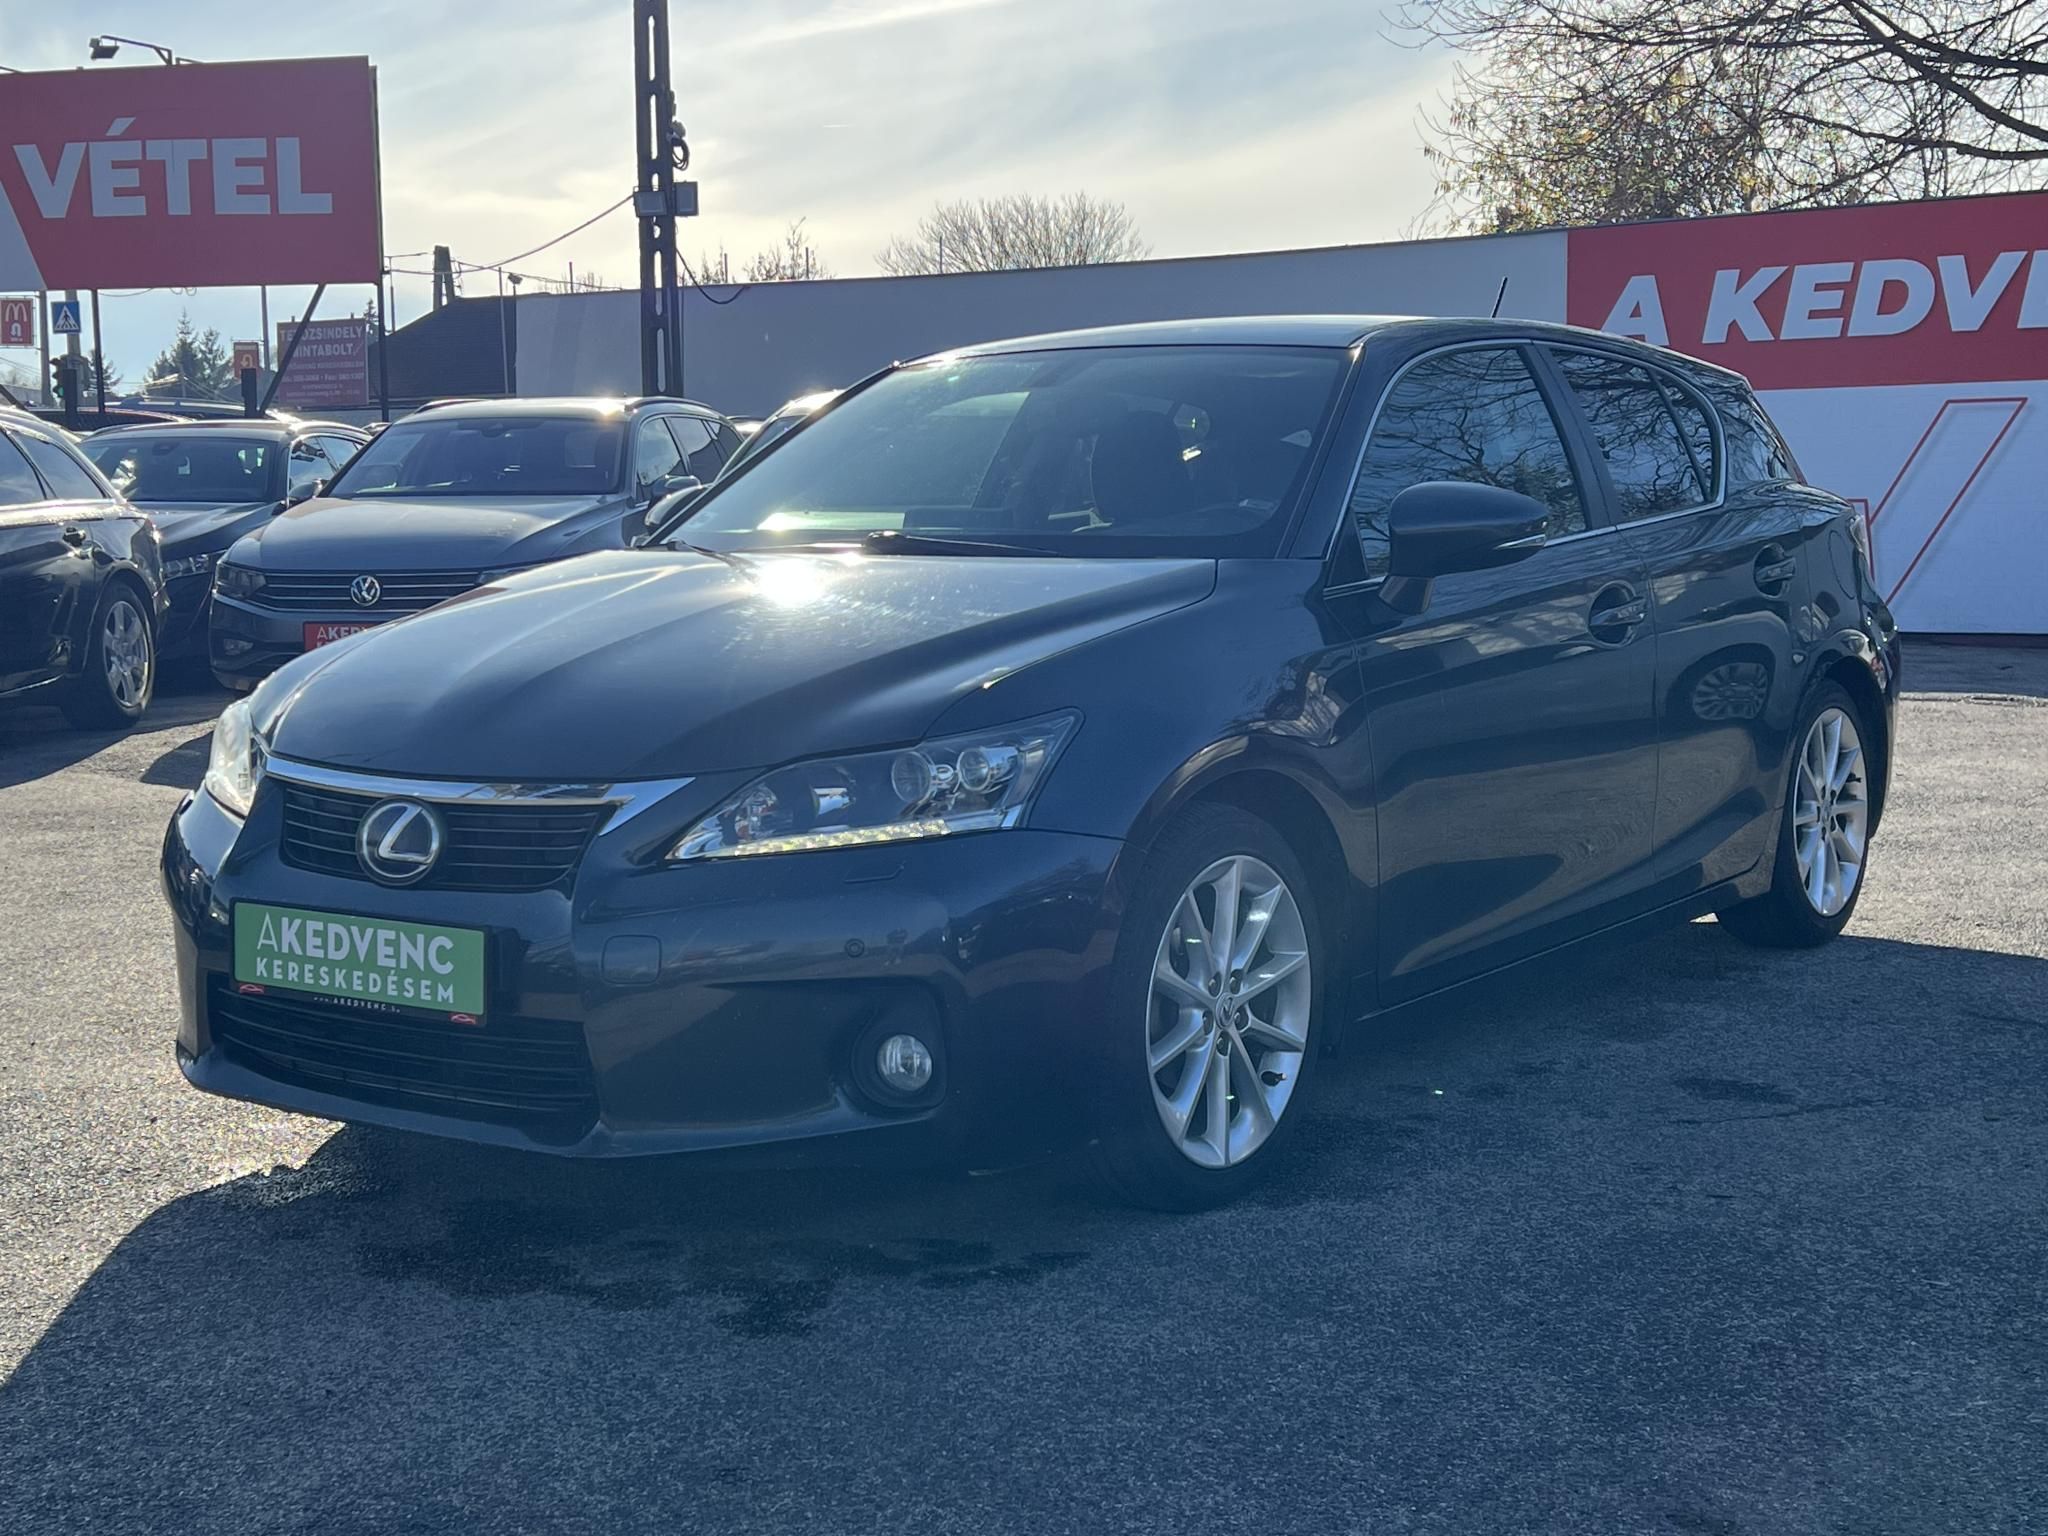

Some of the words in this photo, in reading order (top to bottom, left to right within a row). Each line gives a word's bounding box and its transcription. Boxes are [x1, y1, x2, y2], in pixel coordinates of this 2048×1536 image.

[13, 117, 333, 218] VÉTEL
[1601, 275, 1669, 346] A
[256, 957, 454, 1004] KERESKEDÉSEM
